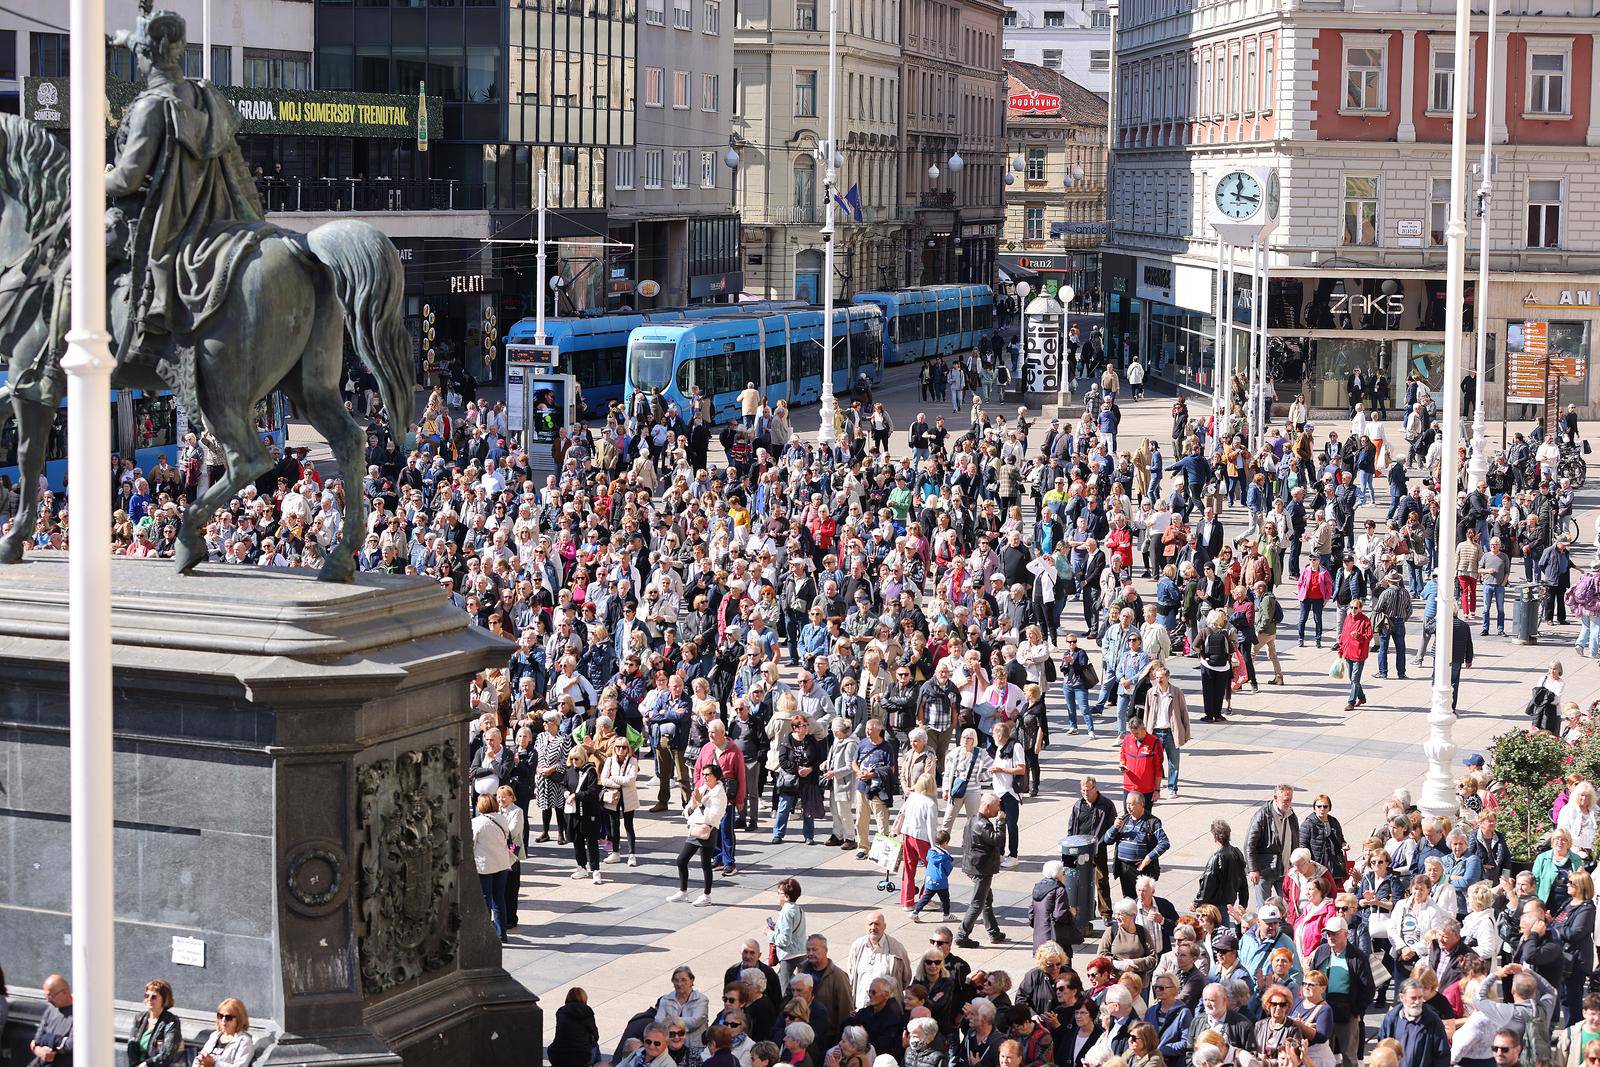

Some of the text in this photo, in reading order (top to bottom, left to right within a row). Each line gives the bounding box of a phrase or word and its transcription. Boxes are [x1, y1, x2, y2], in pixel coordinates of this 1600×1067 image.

[1012, 98, 1057, 106] PODRAVKA
[238, 100, 277, 120] GRADA.
[279, 101, 302, 121] MOJ
[303, 102, 356, 123] SOMERSBY
[357, 104, 409, 126] TRENUTAK.
[451, 275, 485, 293] PELATI
[1329, 294, 1405, 315] ZAKS
[1559, 289, 1600, 305] AN
